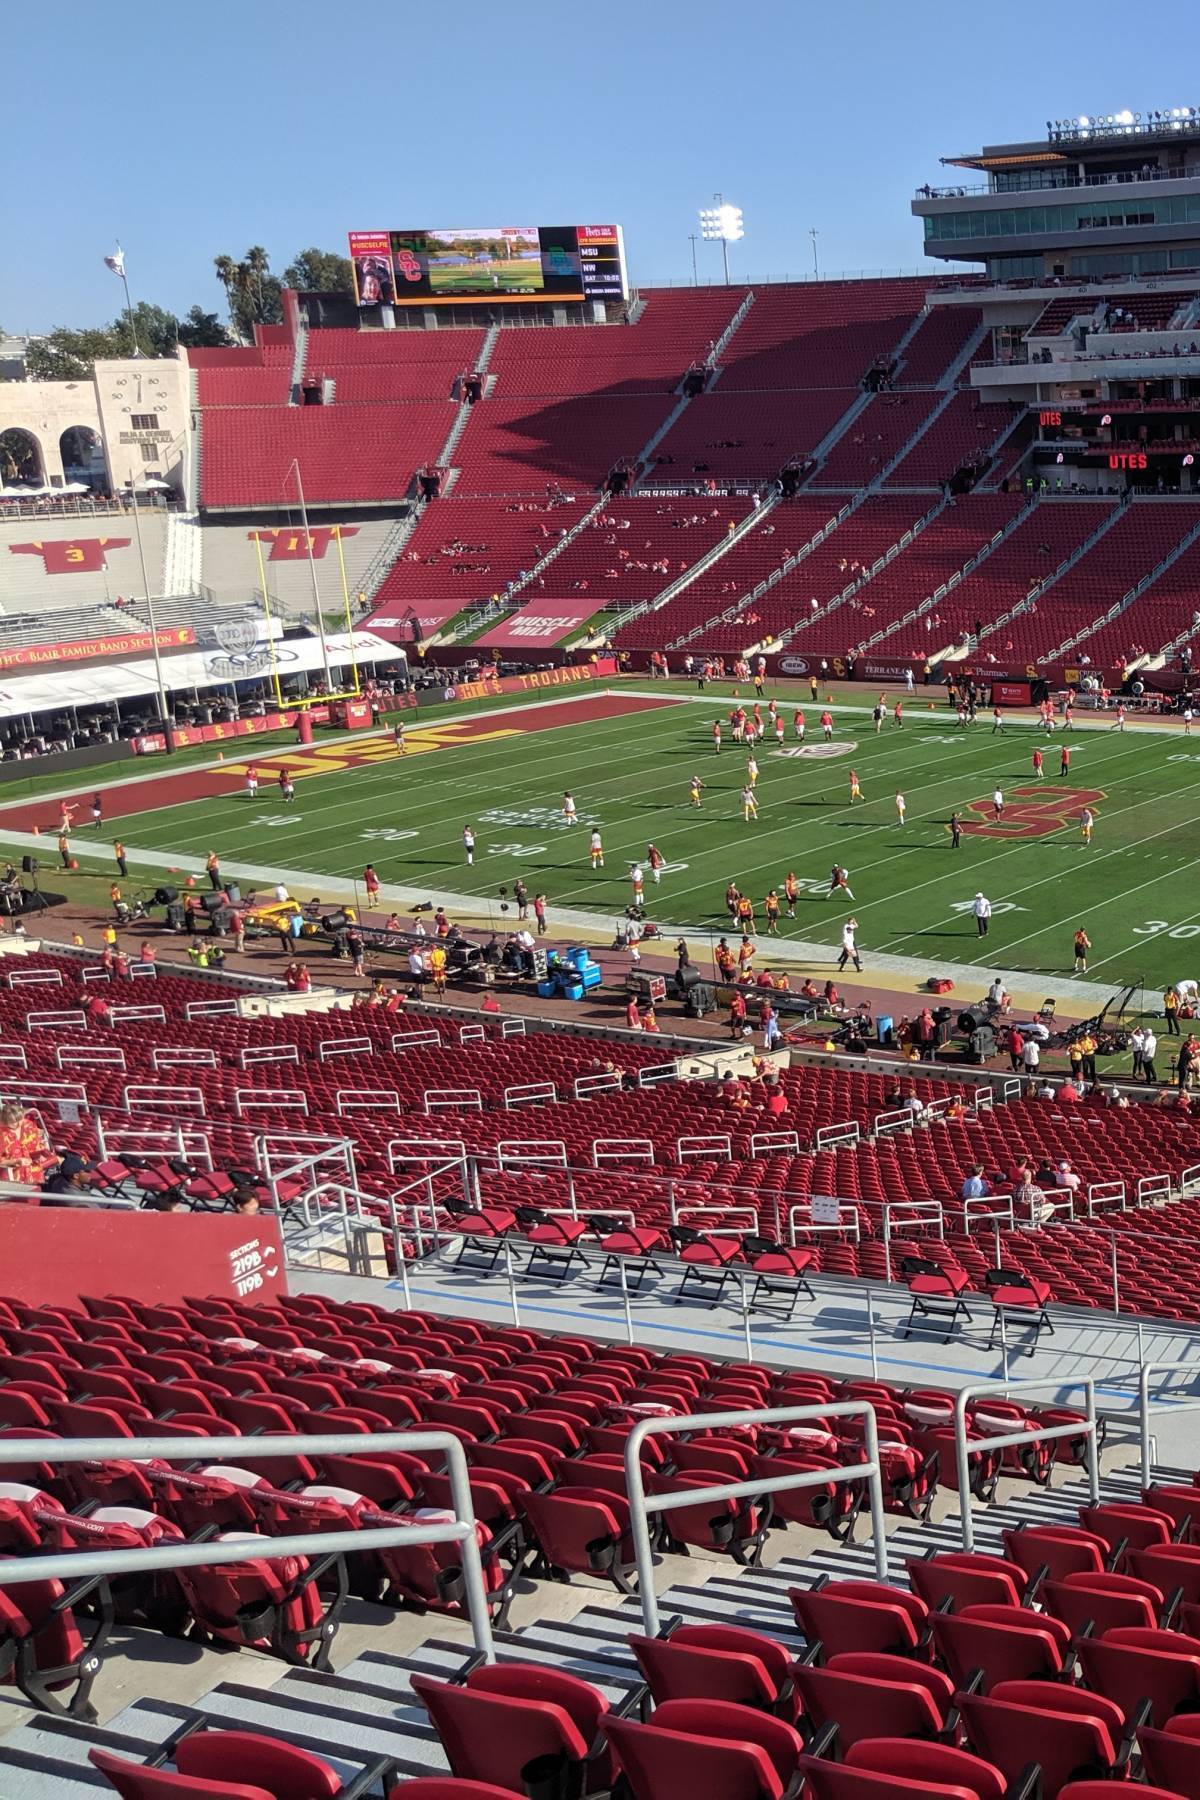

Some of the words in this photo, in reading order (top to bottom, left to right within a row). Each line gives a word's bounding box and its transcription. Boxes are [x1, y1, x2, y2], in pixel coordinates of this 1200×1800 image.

[581, 248, 598, 256] MSU
[583, 264, 596, 272] NW
[1039, 412, 1062, 426] UTES
[1109, 454, 1147, 469] UTES
[67, 549, 85, 563] 3
[508, 616, 584, 628] MUSCLE
[508, 626, 557, 637] MILK
[130, 634, 172, 648] SECTON
[325, 638, 382, 653] Audi
[520, 666, 592, 689] TROJANS
[865, 666, 906, 675] TERRANE
[976, 667, 1009, 678] Pharmacy
[377, 694, 417, 713] UTES
[206, 724, 528, 779] USC
[249, 815, 303, 827] 10
[358, 828, 420, 841] 20
[487, 843, 548, 857] 30
[230, 1238, 260, 1260] SECTIONS
[232, 1251, 261, 1277] 219B
[237, 1273, 263, 1297] 119B
[327, 1624, 335, 1636] 9
[85, 1658, 99, 1672] 10
